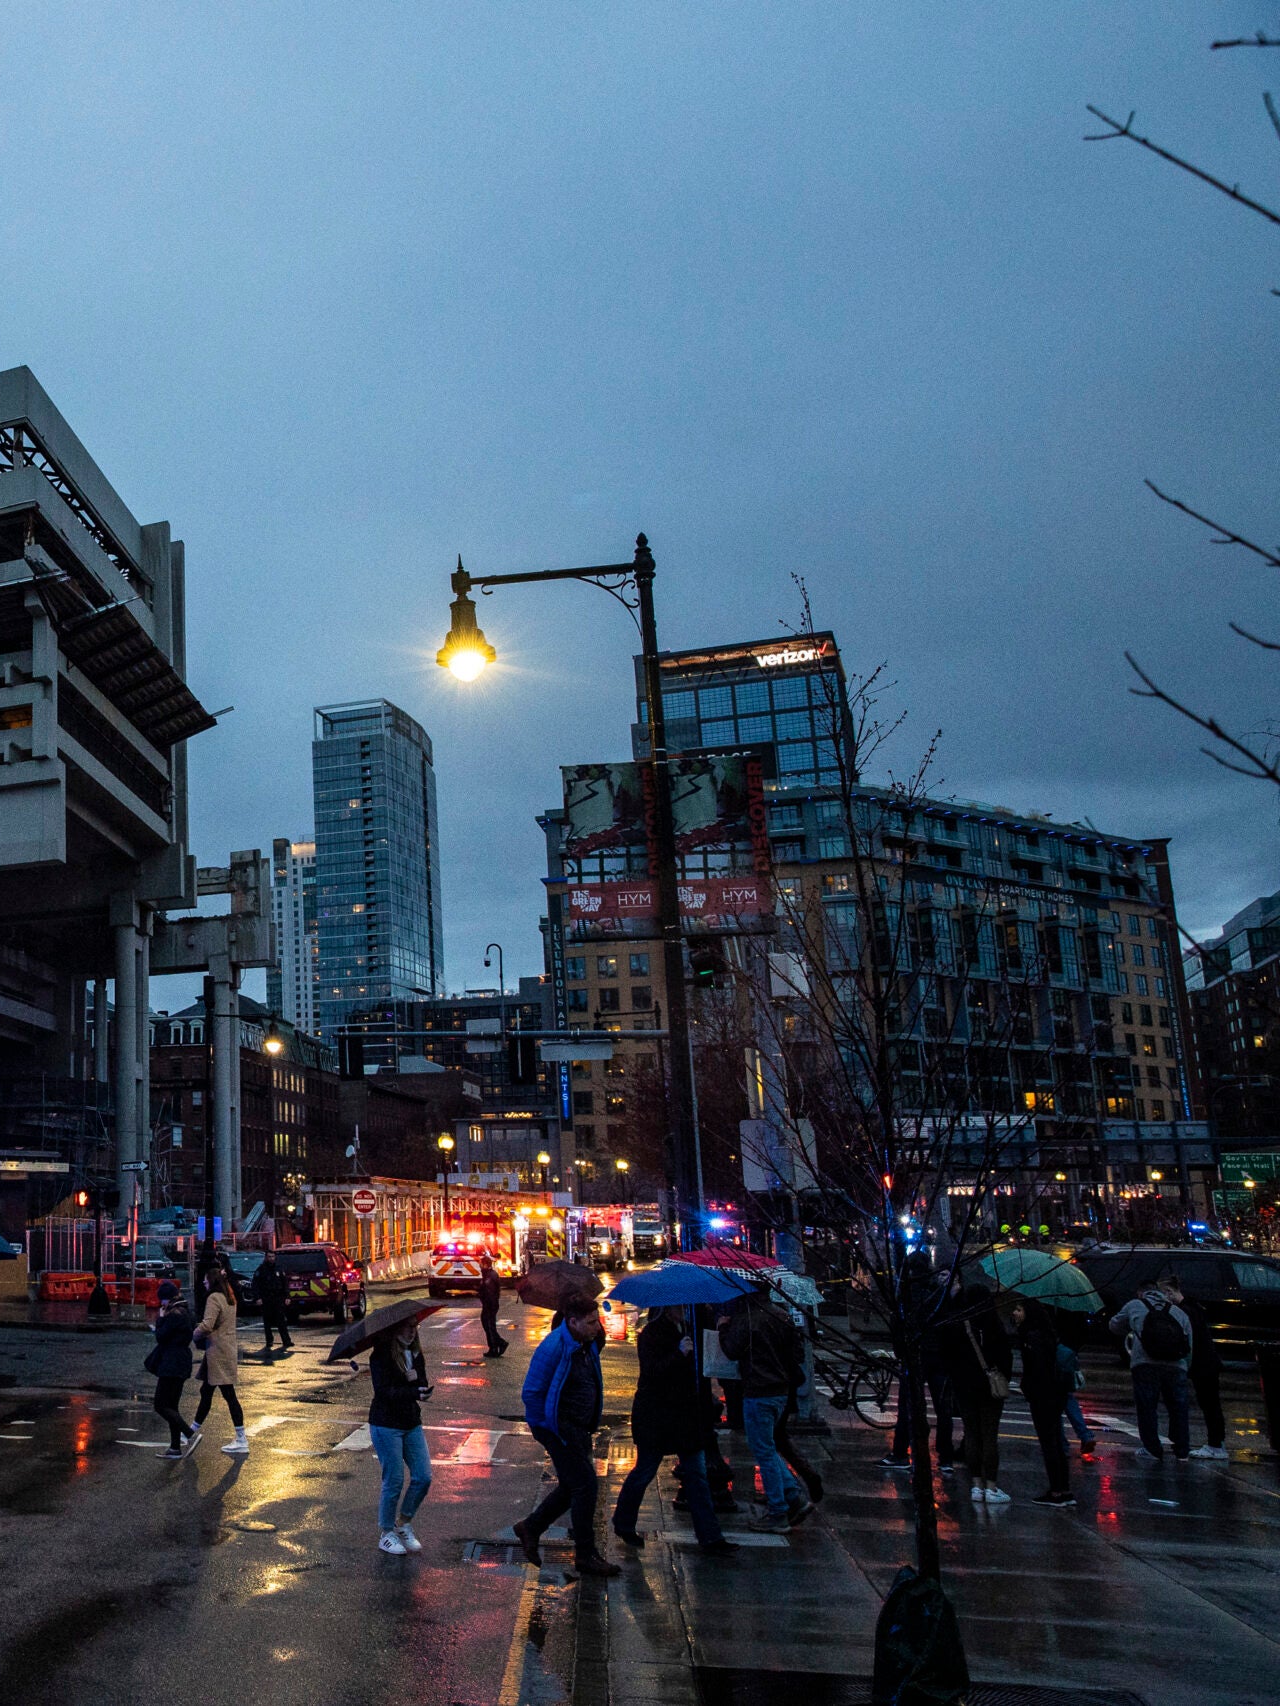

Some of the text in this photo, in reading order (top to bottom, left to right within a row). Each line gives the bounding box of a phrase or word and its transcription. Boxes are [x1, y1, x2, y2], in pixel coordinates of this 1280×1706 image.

[756, 648, 820, 668] verizon
[746, 759, 770, 873] DISCOVER
[571, 890, 590, 898] THE
[617, 893, 651, 906] HYM
[722, 889, 757, 902] HYM
[571, 896, 602, 906] GREEN
